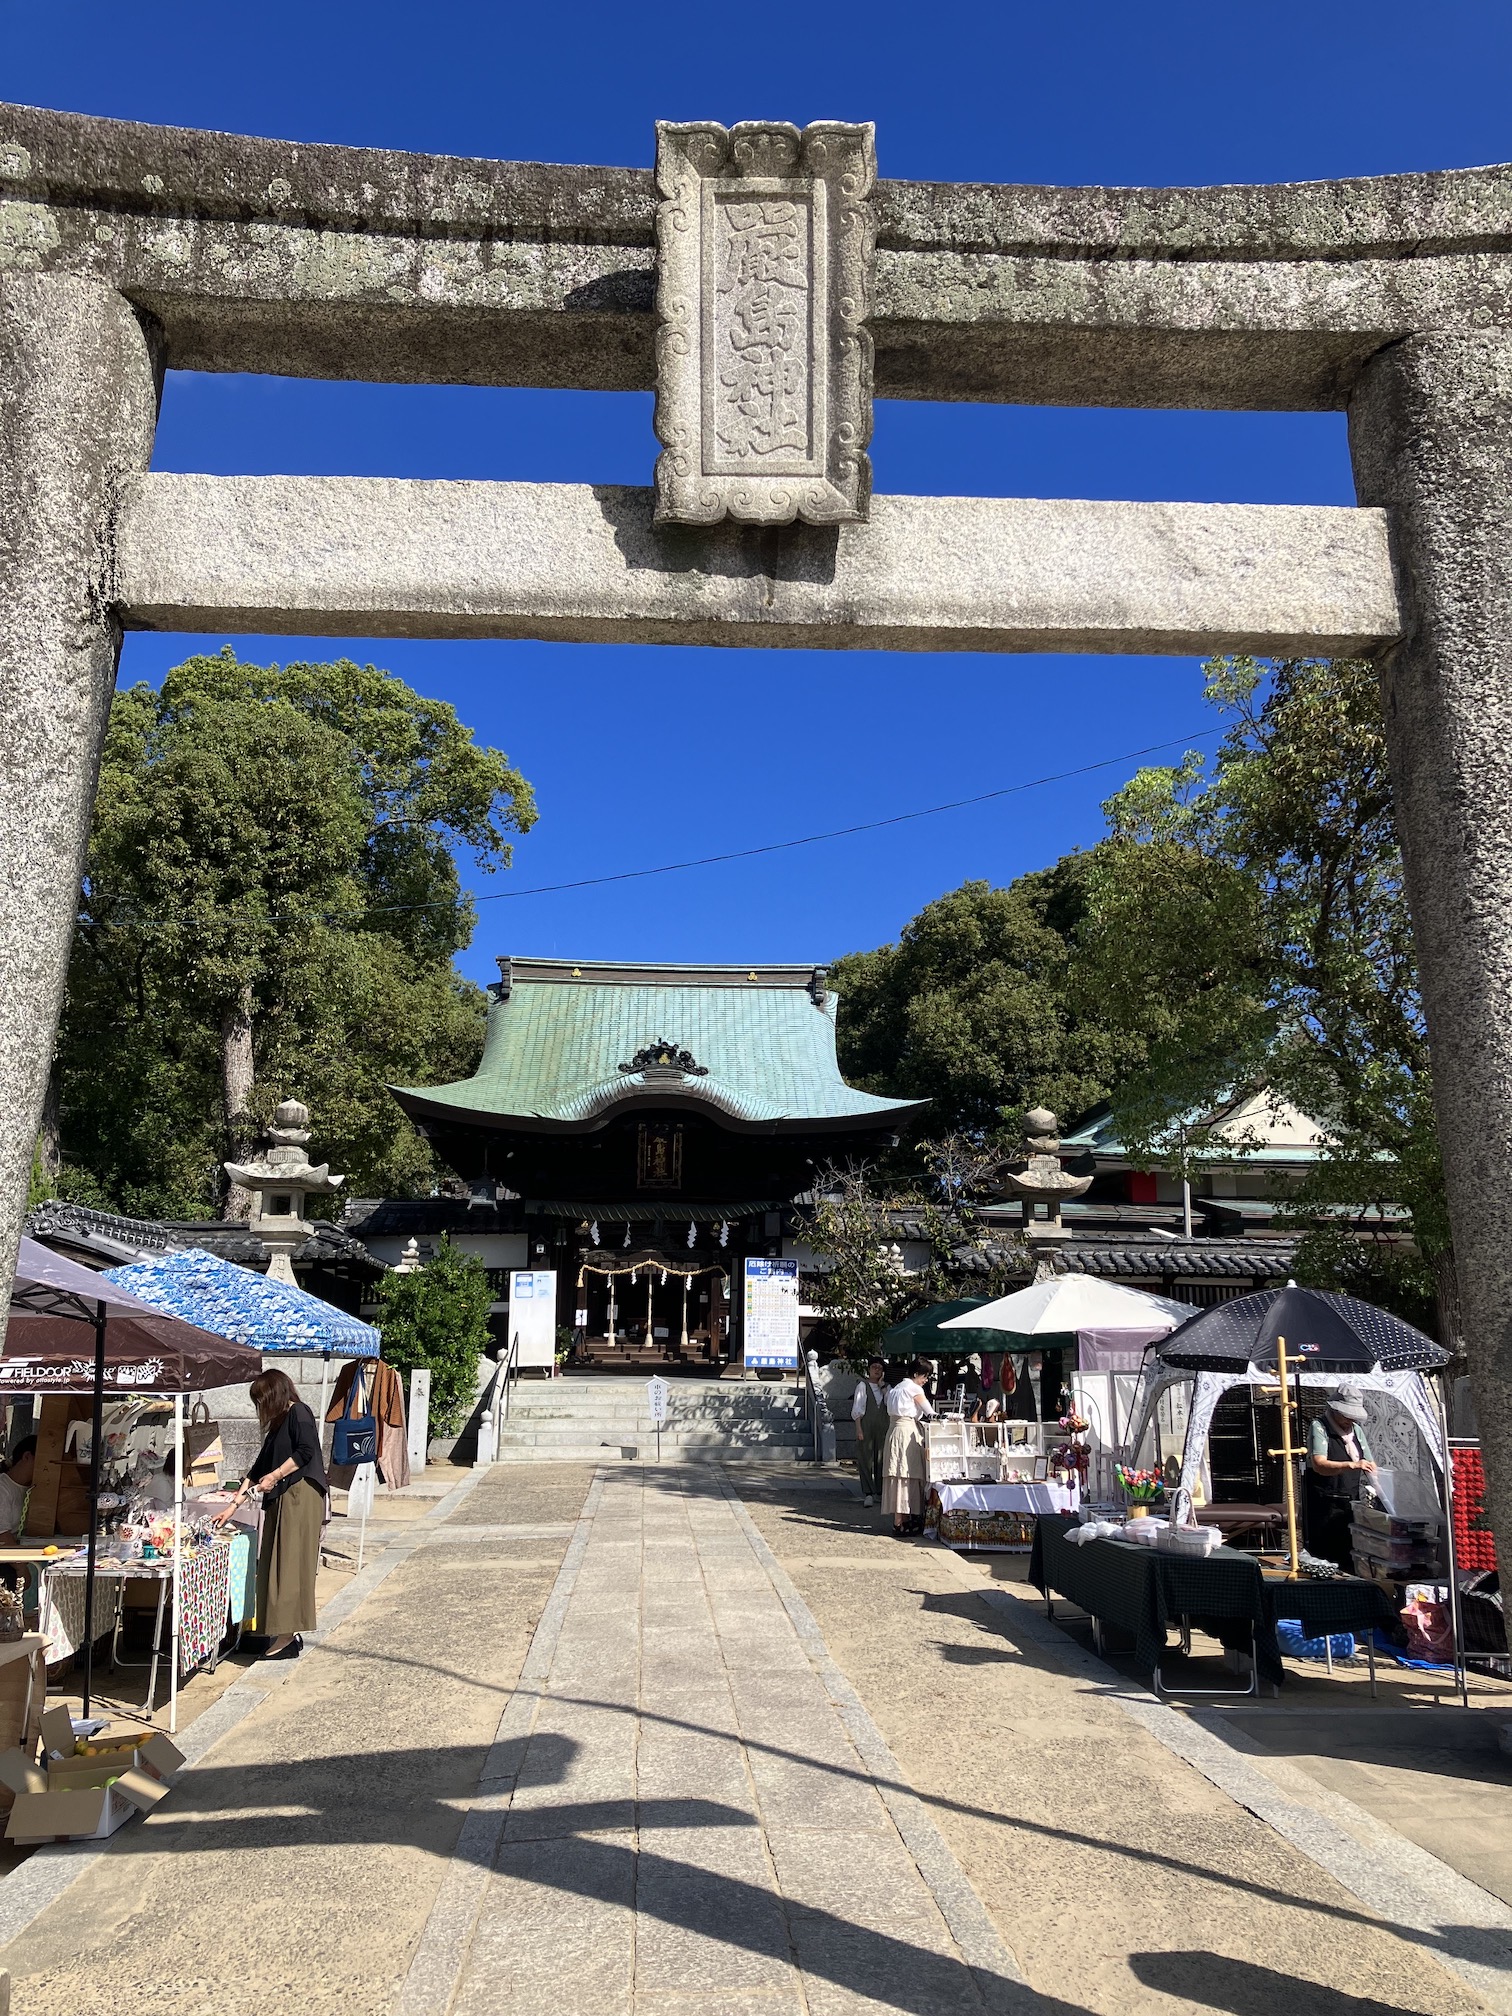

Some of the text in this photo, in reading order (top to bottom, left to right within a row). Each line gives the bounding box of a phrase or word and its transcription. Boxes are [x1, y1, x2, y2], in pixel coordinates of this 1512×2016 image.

[748, 1260, 795, 1268] 厄除け祈願の
[759, 1267, 785, 1275] ご案内
[14, 1367, 71, 1378] FIELDOOR
[26, 1377, 35, 1385] by
[654, 1384, 662, 1418] 車のお祓い所
